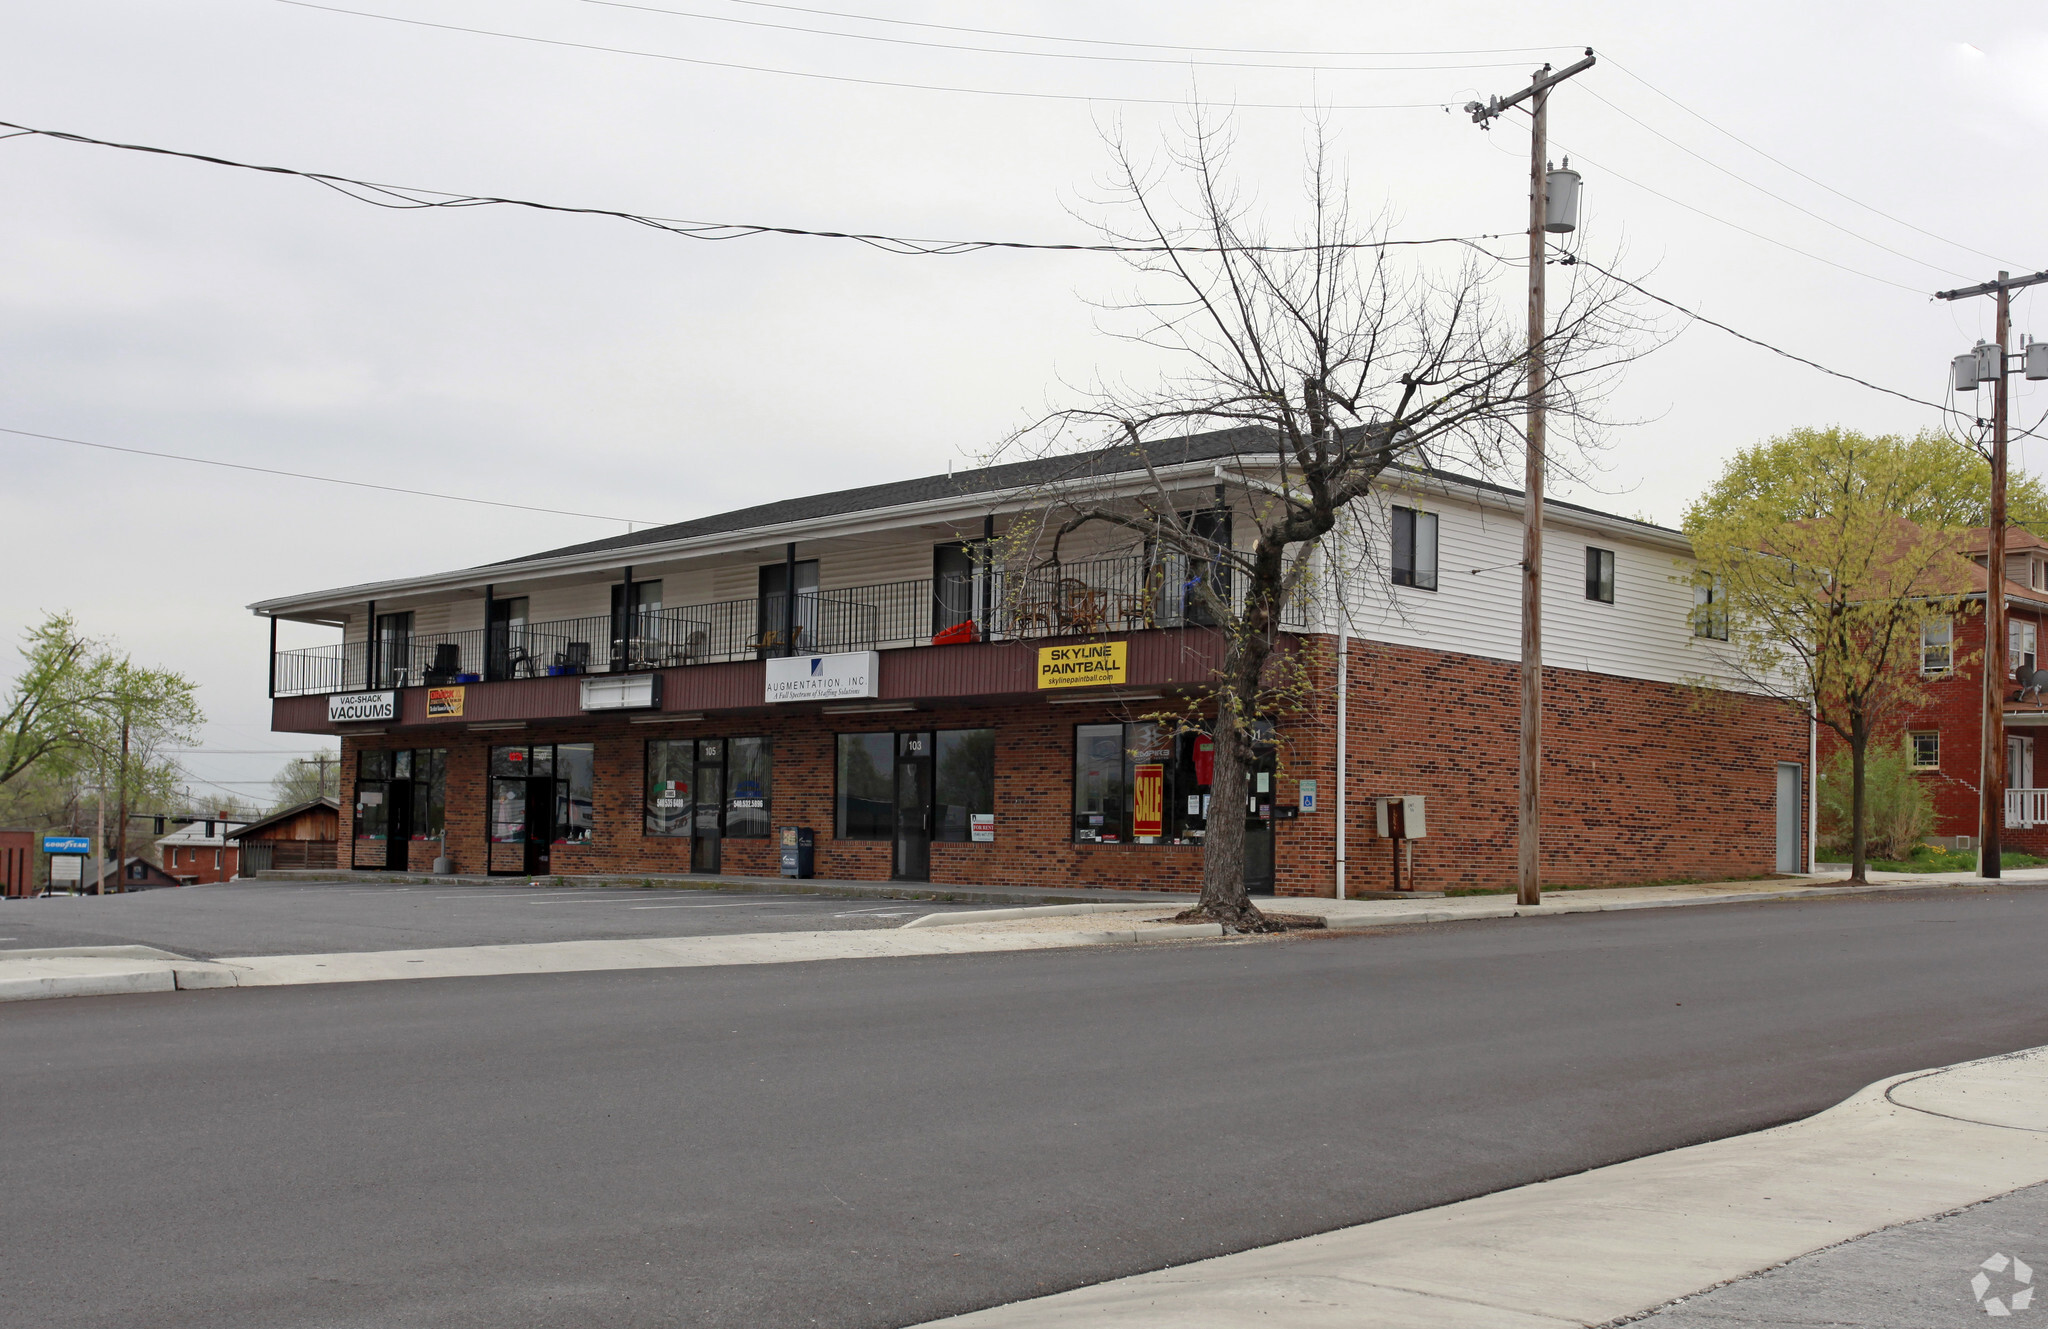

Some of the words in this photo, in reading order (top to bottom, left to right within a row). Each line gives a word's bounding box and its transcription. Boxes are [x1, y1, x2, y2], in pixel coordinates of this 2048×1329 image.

[1051, 645, 1112, 661] SKYLINE
[1043, 659, 1121, 675] PAINTBALL
[1048, 674, 1114, 685] skylinepaintball.com
[779, 691, 789, 699] Full
[789, 689, 811, 699] Spectrum
[812, 689, 817, 698] of
[818, 687, 837, 697] Staffing
[838, 686, 860, 695] Solutions
[340, 694, 382, 704] VAC-SHACK
[330, 703, 392, 719] VACUUMS
[706, 746, 716, 756] 105
[909, 741, 921, 750] 103
[1136, 776, 1161, 822] SALE
[45, 841, 87, 849] GOODYEAR
